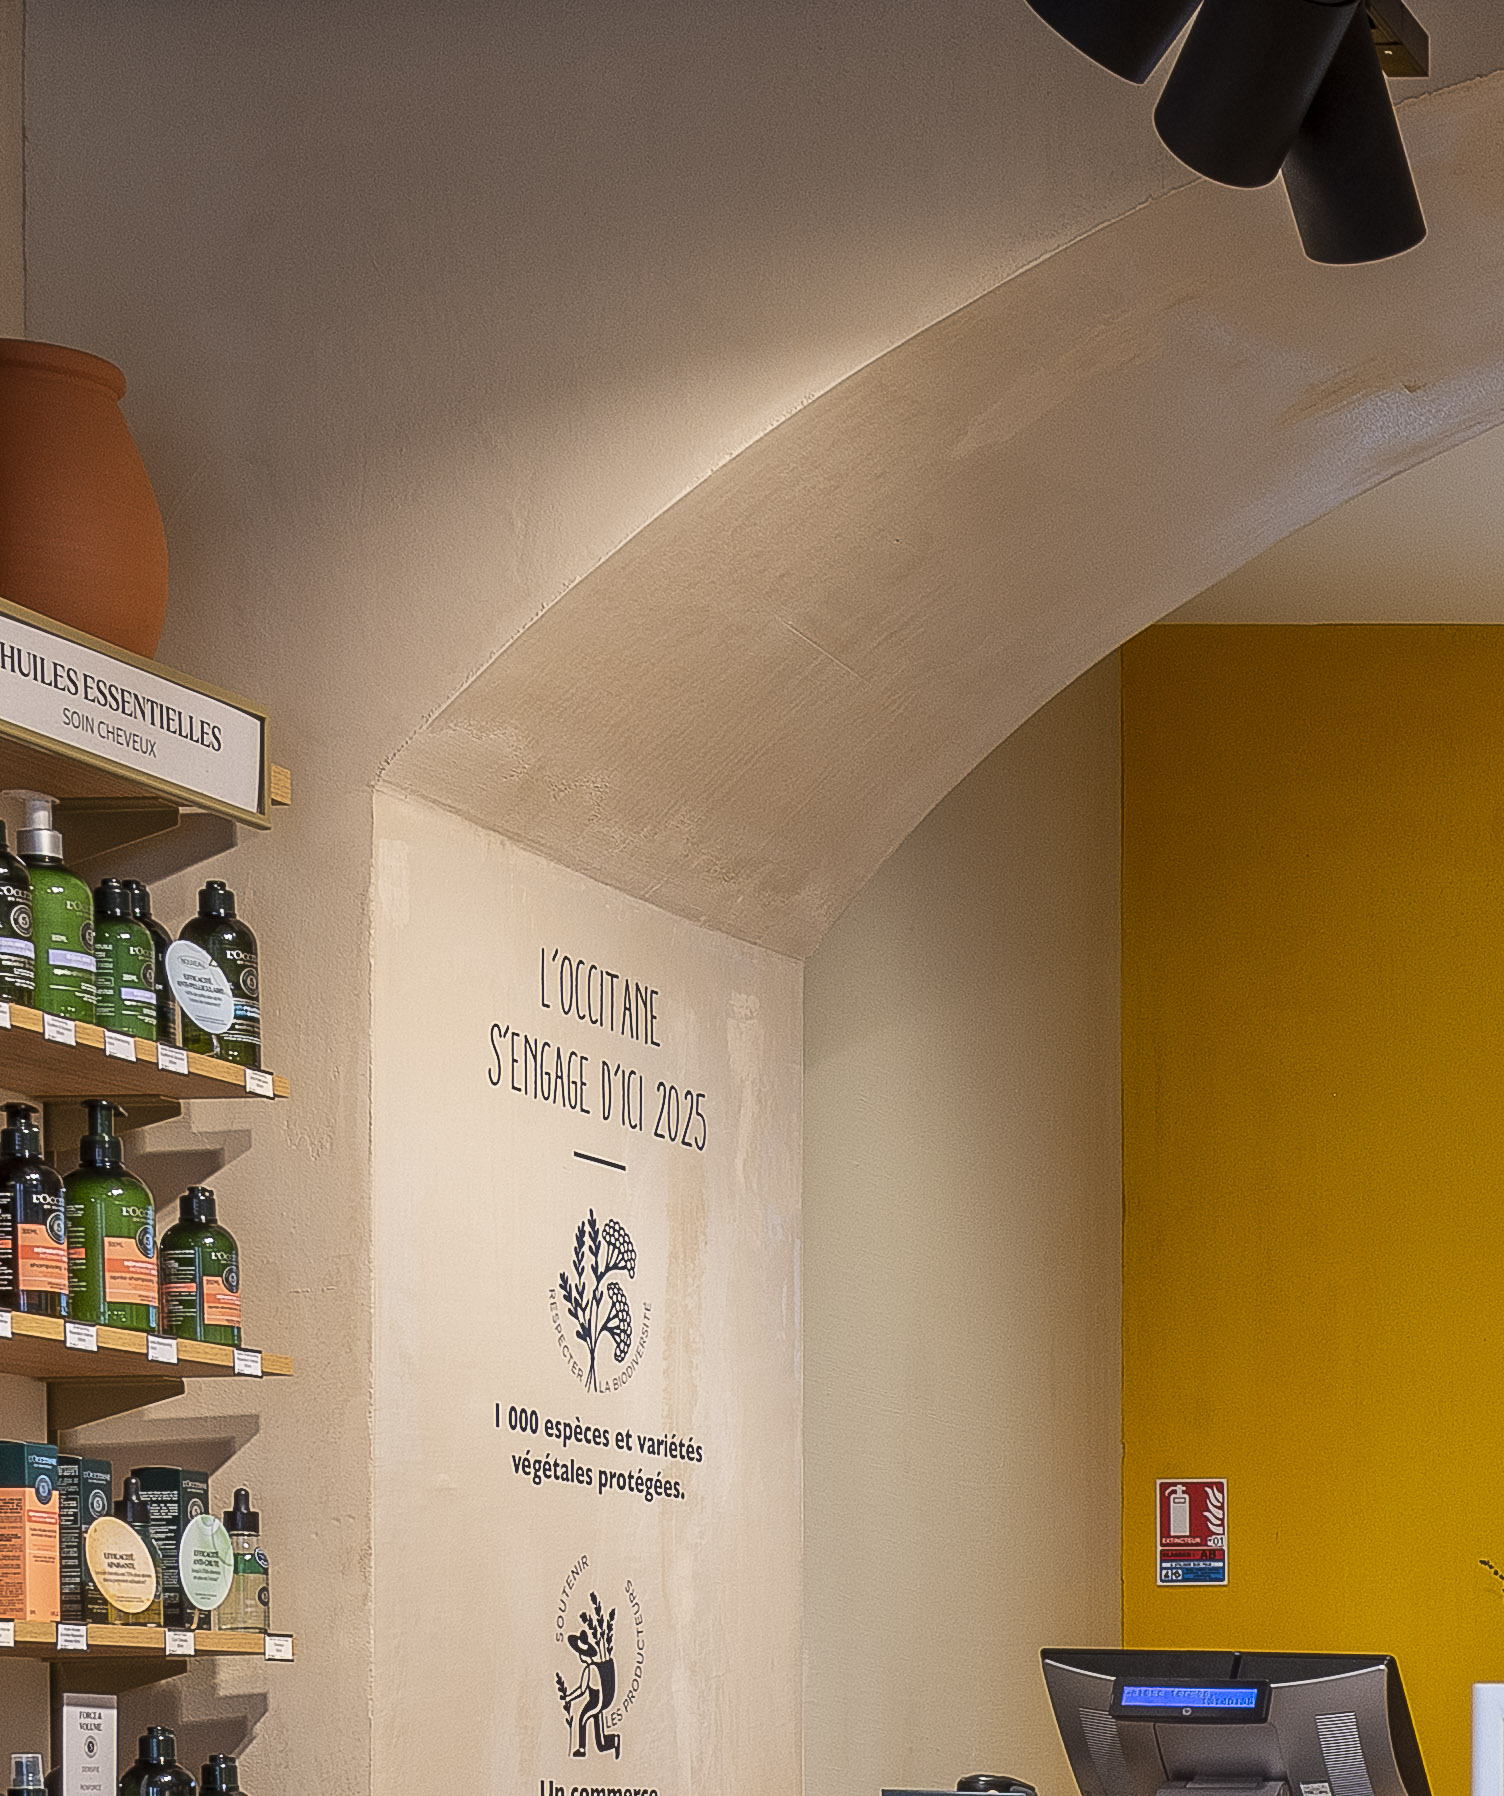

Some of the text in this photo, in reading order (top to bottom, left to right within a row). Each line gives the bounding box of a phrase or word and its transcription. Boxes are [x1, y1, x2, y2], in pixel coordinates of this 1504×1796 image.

[0, 641, 222, 752] HUILES ESSENTIELLES
[62, 707, 157, 758] SOIN CHEVEUX
[541, 948, 660, 1047] L'OCCITANE
[488, 1023, 706, 1151] S'ENGAGE D'ICI 2025
[548, 1288, 652, 1393] RESPECTER LA BIODIVERSITÉ
[508, 1406, 539, 1435] 000
[544, 1416, 610, 1448] espèces
[615, 1429, 633, 1451] et
[636, 1434, 703, 1463] variétés
[511, 1450, 685, 1503] végétales protégées.
[556, 1554, 589, 1643] SOUTENIR
[605, 1579, 645, 1729] LES PRODUCTEURS
